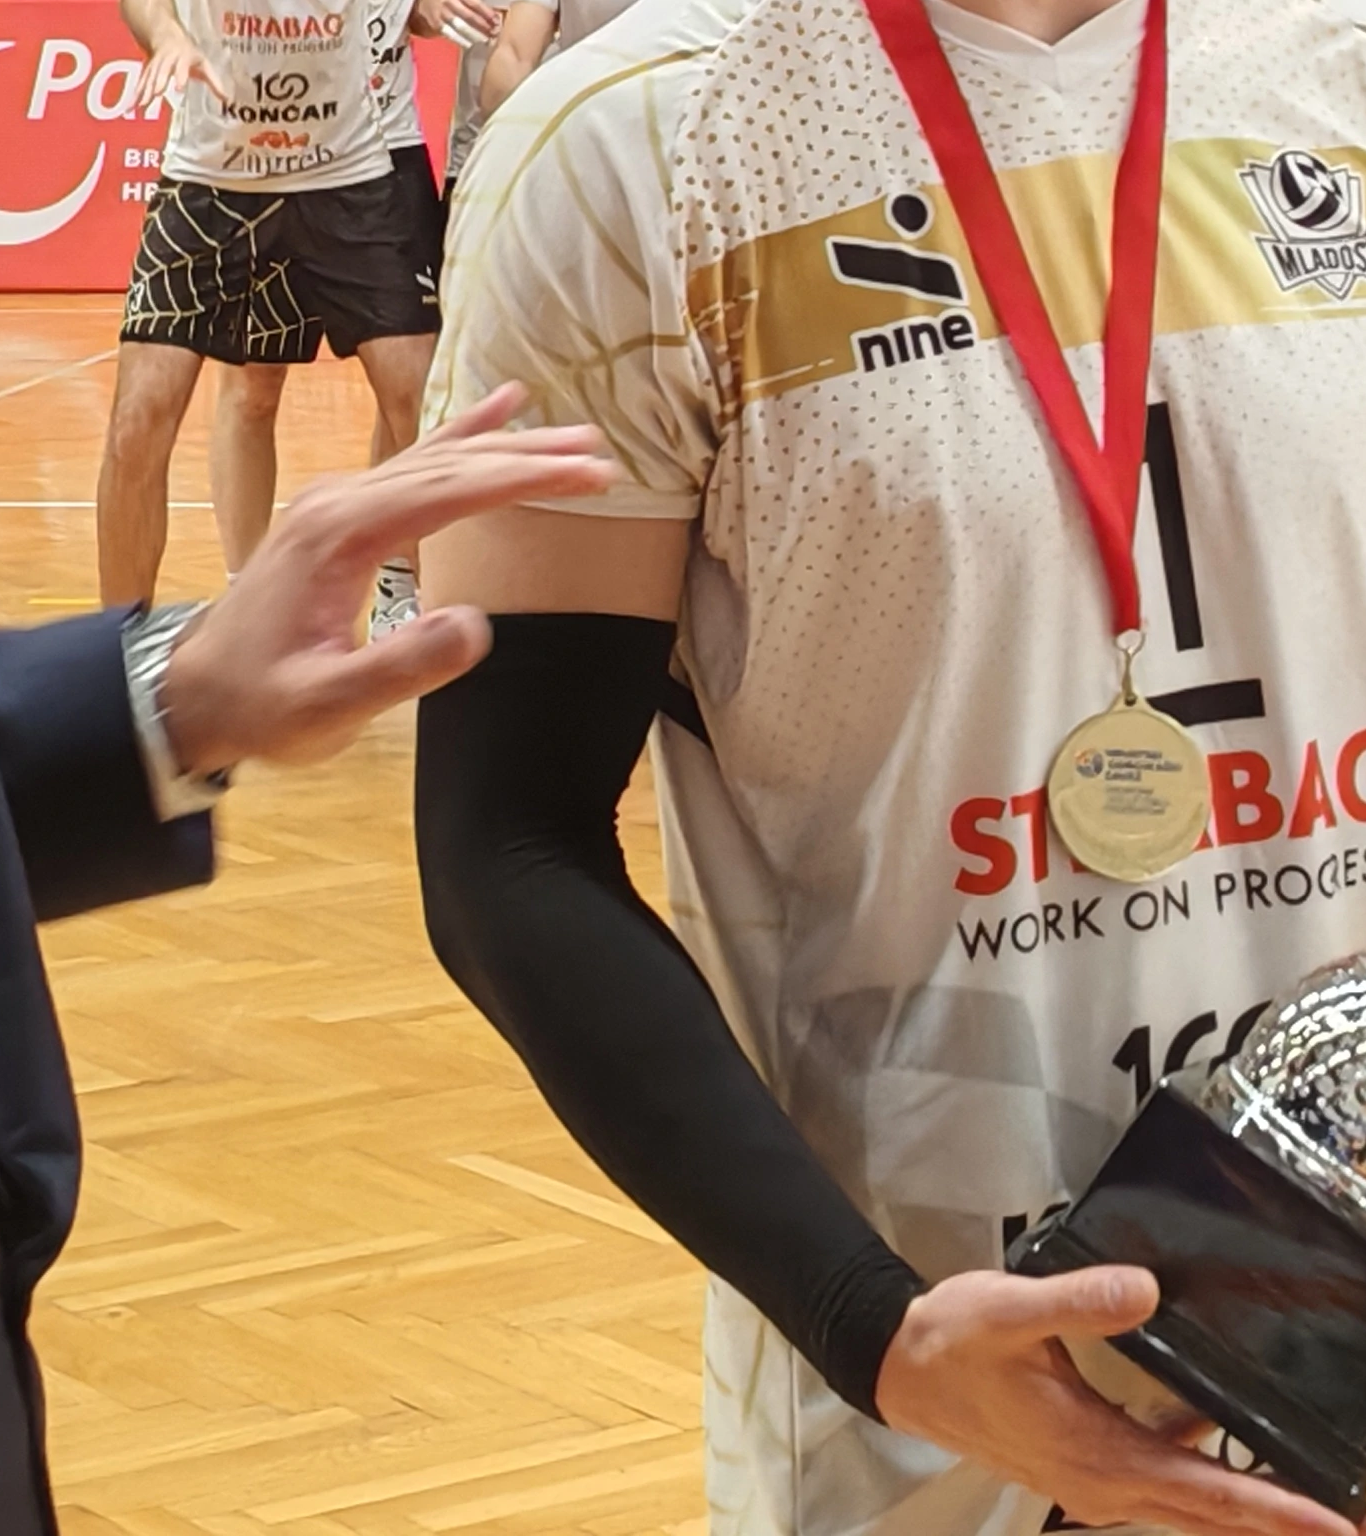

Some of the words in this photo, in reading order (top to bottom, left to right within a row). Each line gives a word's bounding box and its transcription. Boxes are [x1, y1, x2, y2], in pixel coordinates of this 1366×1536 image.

[858, 314, 975, 373] nine
[957, 897, 1105, 962] WORK
[1123, 881, 1190, 932] ON
